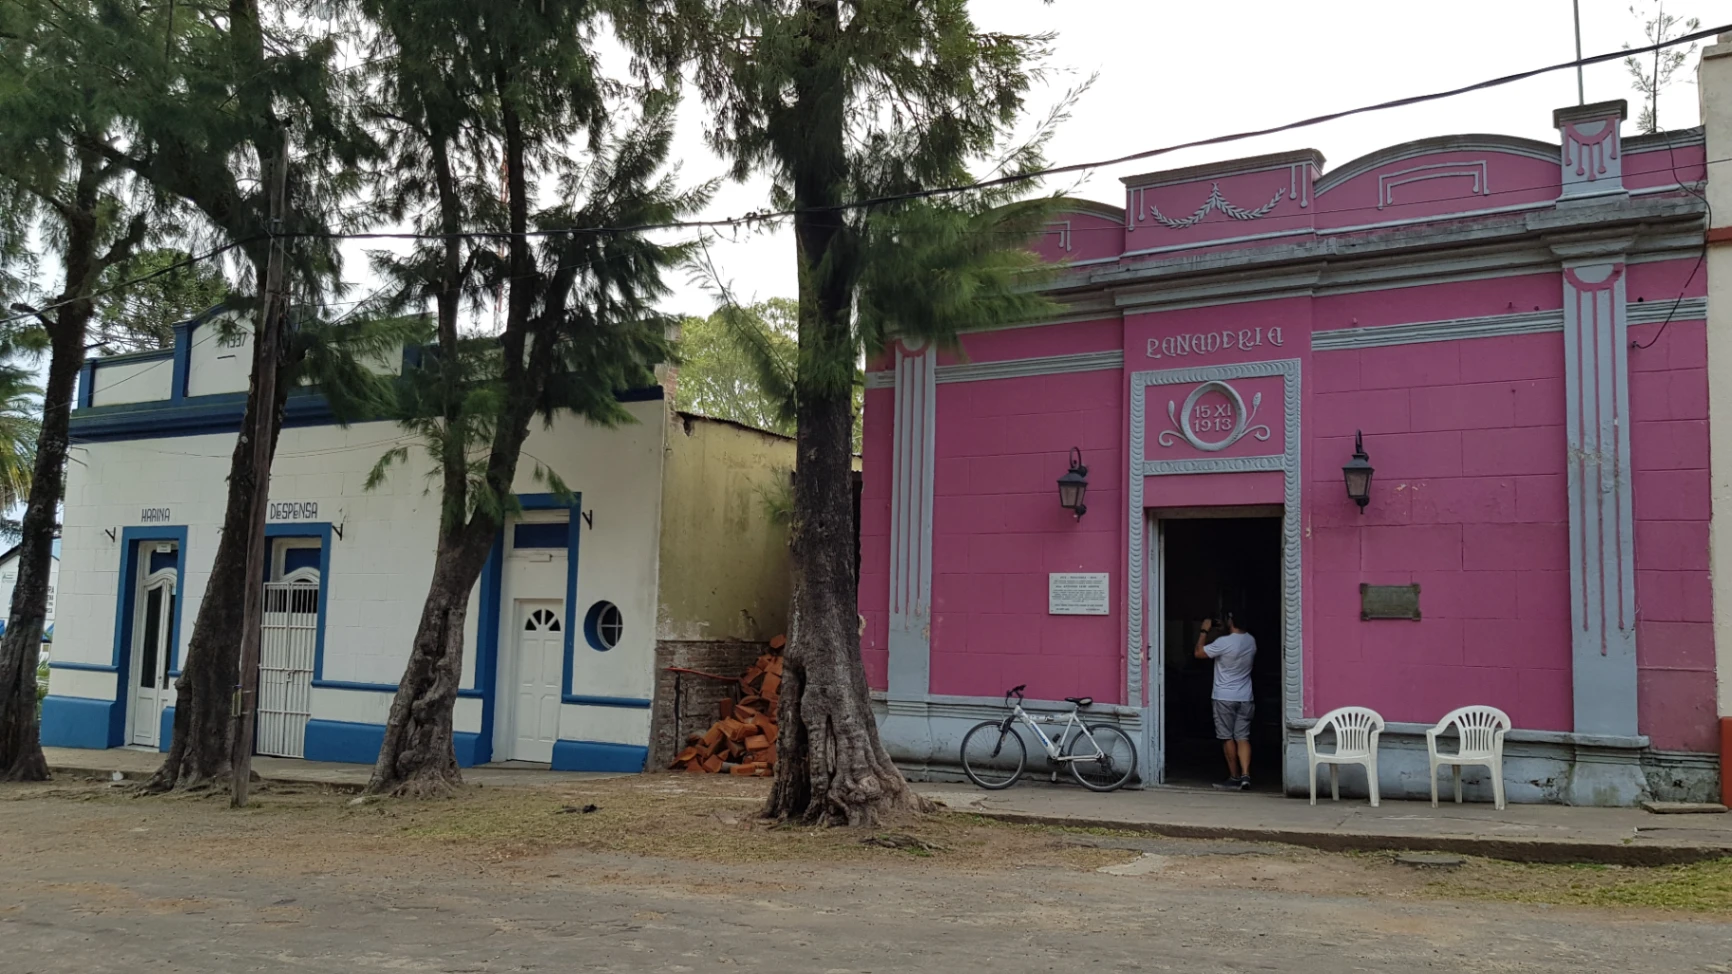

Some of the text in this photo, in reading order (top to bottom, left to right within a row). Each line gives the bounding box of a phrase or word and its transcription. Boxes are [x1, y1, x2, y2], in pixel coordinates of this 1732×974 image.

[1146, 326, 1285, 359] PANADERIA
[1194, 403, 1232, 418] 15 XI
[1194, 418, 1232, 432] 1913
[270, 502, 318, 519] DESPENSA
